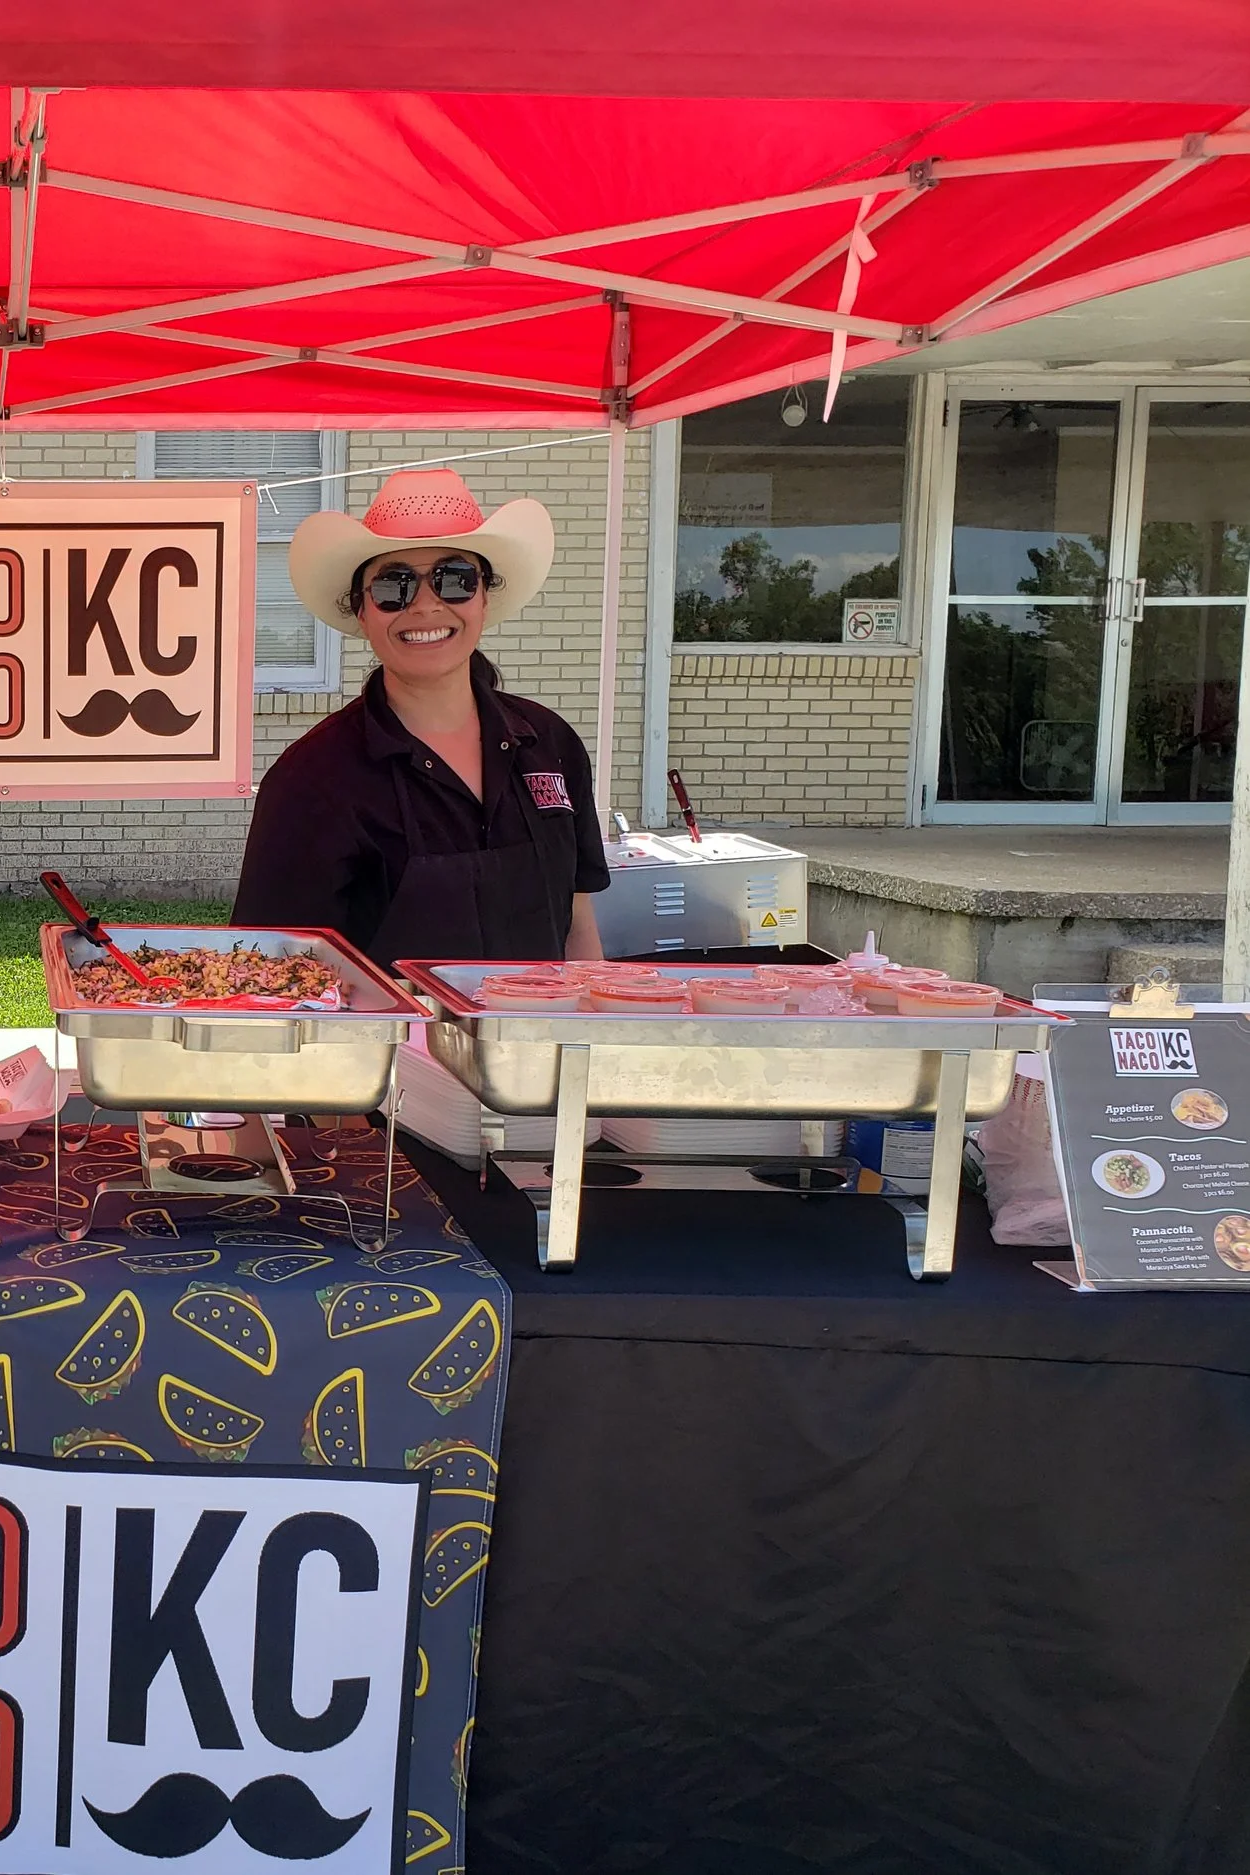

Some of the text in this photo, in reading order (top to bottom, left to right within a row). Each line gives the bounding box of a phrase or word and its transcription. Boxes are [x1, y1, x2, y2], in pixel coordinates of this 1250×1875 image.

[67, 546, 199, 677] KC
[524, 776, 554, 791] TACO
[1114, 1032, 1190, 1058] TACO KC
[1117, 1052, 1160, 1070] NACO
[1105, 1104, 1155, 1115] Appetizer
[1169, 1153, 1201, 1162] Tacos
[1132, 1226, 1194, 1236] Pannacotta
[107, 1505, 380, 1754] KC
